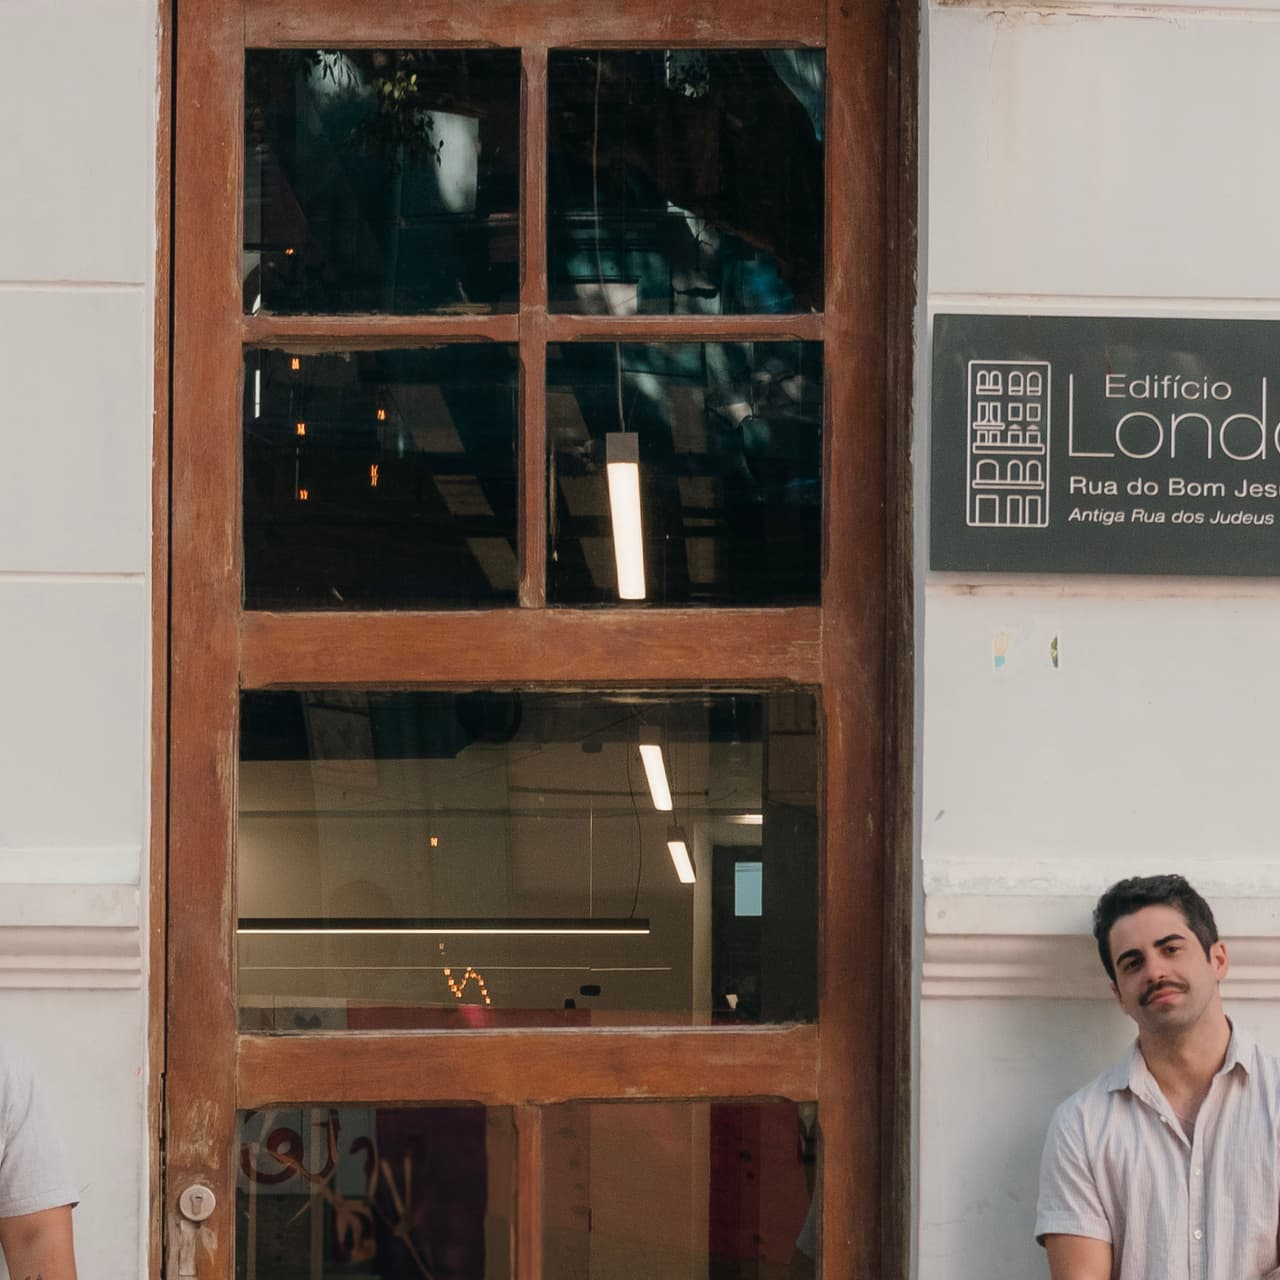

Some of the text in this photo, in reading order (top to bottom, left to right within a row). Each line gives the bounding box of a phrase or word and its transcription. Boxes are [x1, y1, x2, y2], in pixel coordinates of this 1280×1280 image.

[1105, 373, 1232, 400] Edifício
[1069, 475, 1118, 496] Rua
[1126, 477, 1159, 496] do
[1168, 477, 1226, 497] Bom
[1067, 507, 1125, 526] Antiga
[1130, 508, 1166, 524] Rua
[1171, 509, 1205, 524] dos
[1209, 510, 1275, 525] Judeus
